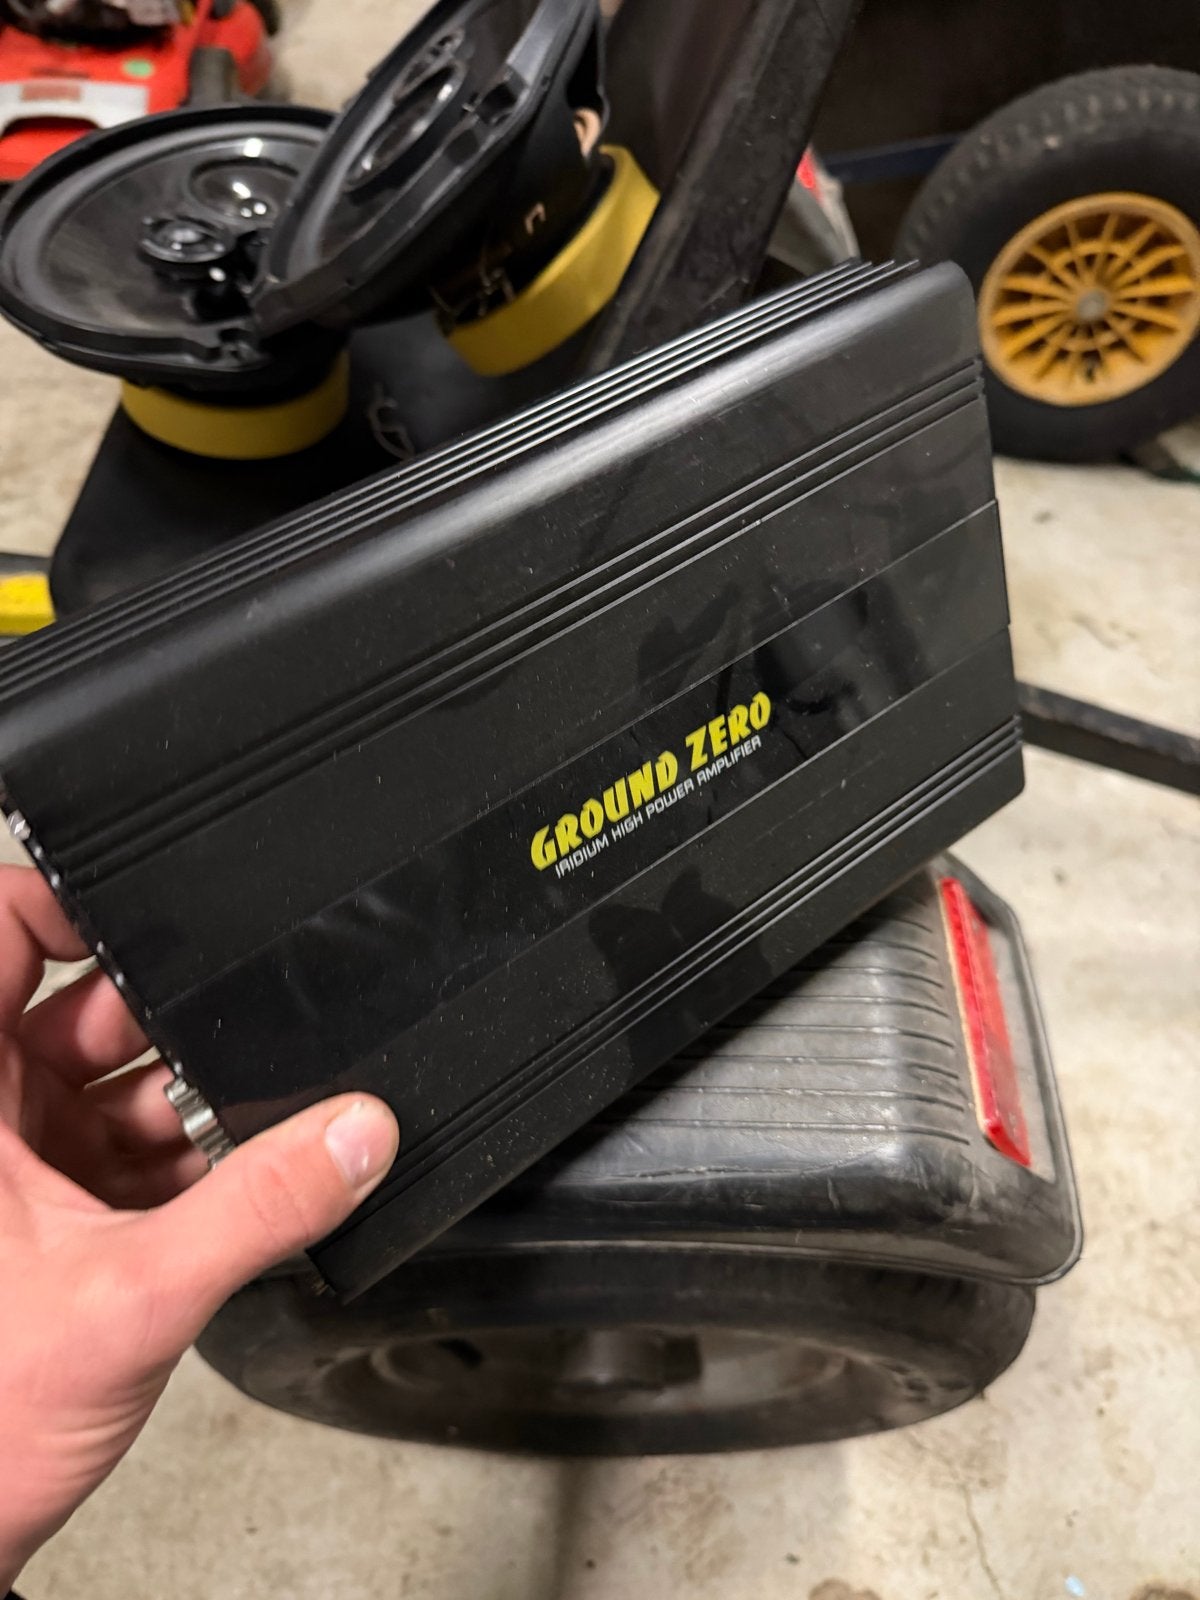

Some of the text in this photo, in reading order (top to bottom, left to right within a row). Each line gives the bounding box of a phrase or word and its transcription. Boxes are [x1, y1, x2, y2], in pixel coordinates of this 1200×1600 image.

[530, 691, 771, 871] GROUND ZERO
[555, 734, 762, 878] IRIDIUM HIGH POWER AMPLIFIER
